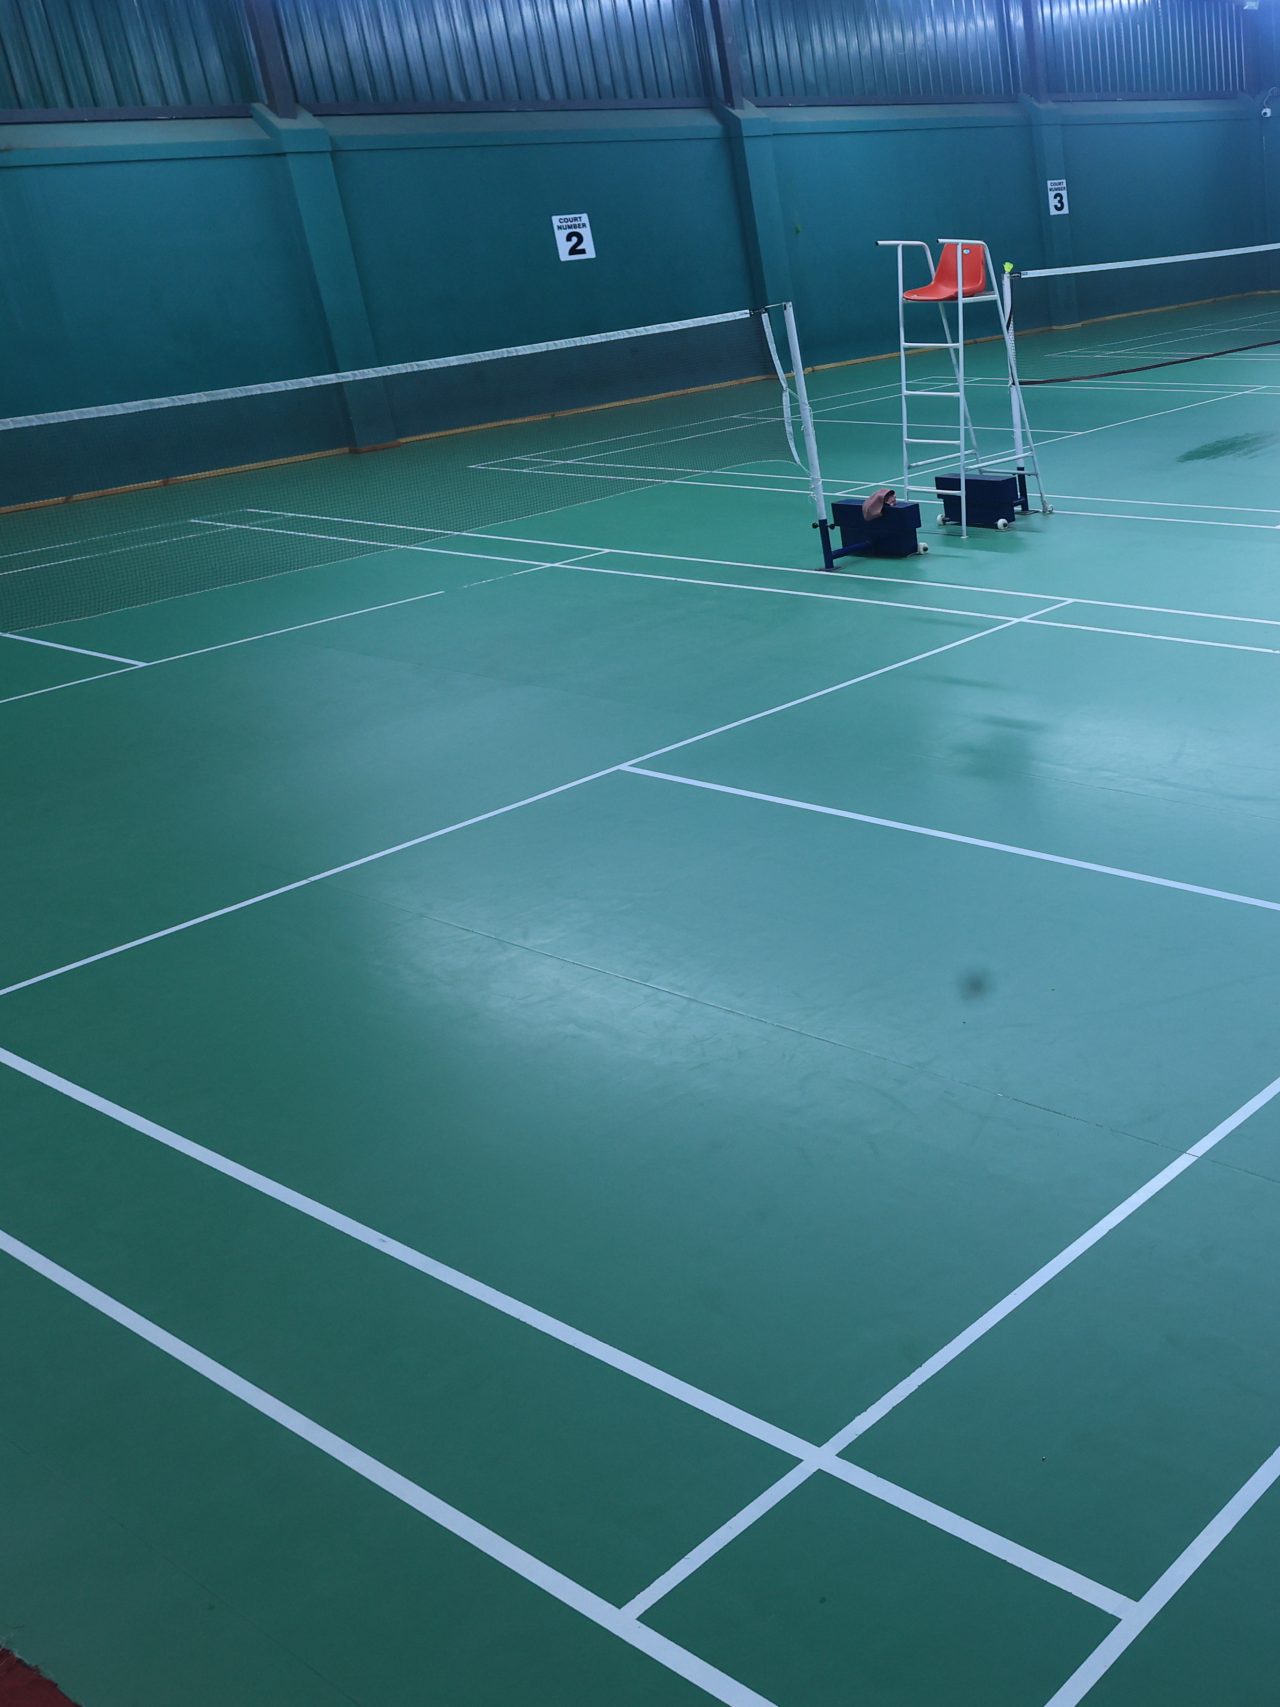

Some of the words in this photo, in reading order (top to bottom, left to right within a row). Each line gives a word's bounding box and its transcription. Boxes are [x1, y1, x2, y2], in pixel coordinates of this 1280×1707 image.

[1053, 192, 1065, 212] 3
[557, 223, 587, 231] NUMBER
[558, 216, 582, 224] COURT
[565, 231, 587, 256] 2
